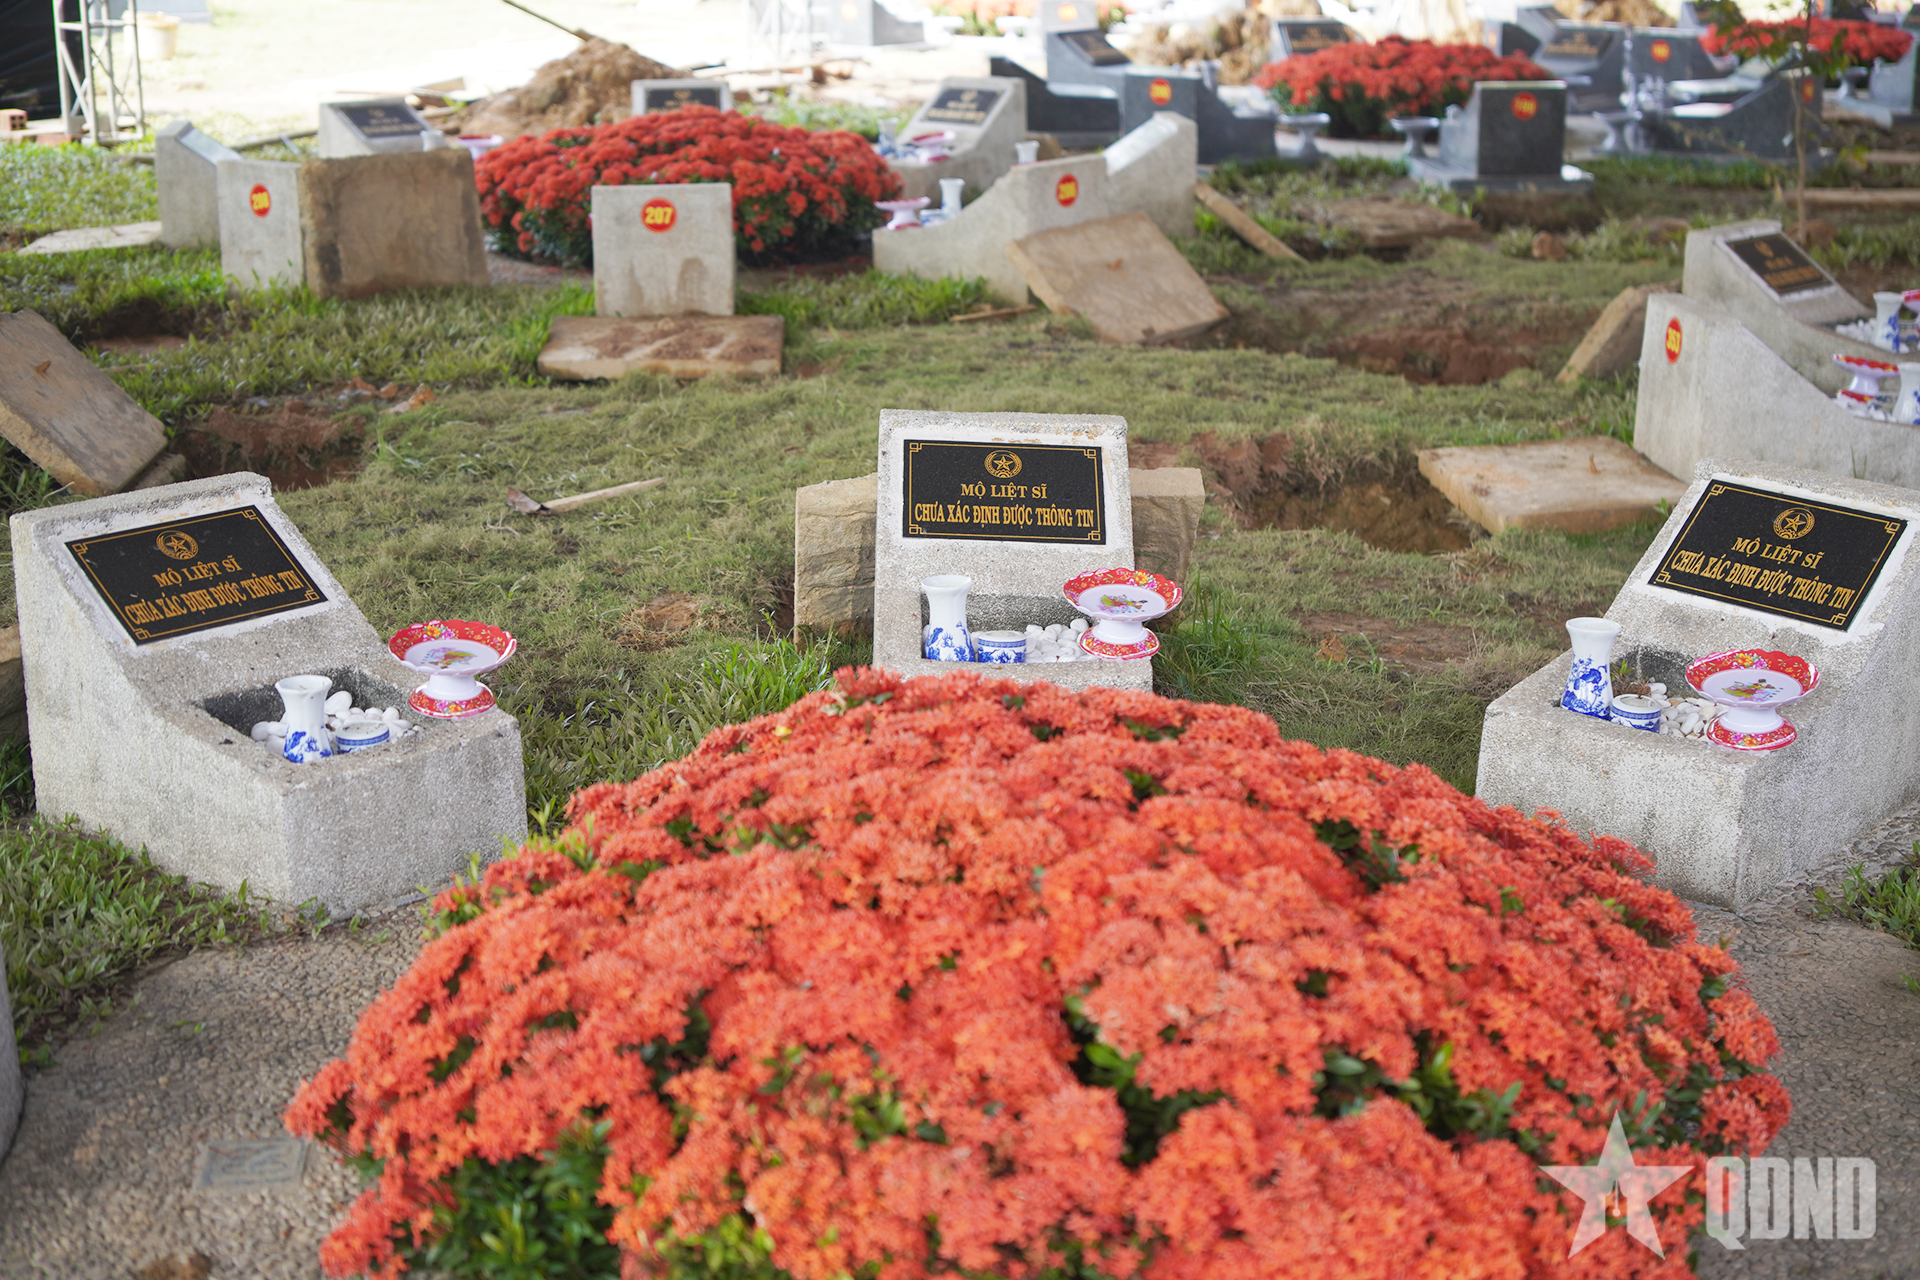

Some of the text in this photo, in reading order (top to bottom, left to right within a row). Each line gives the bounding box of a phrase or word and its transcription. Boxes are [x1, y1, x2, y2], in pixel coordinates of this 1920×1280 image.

[645, 206, 672, 224] 207
[1667, 326, 1680, 354] 353
[961, 481, 1048, 501] MỘ LIỆT SĨ
[914, 500, 1094, 530] CHƯA XÁC ĐỊNH ĐƯỢC THÔNG TIN
[1731, 537, 1826, 570] MỘ LIỆT SĨ
[152, 554, 243, 588] MỘ LIỆT SĨ
[1671, 550, 1856, 610] CHƯA XÁC ĐỊNH ĐƯỢC THÔNG TIN
[124, 569, 305, 625] CHƯA XÁC ĐỊNH ĐƯỢC THÔNG TIN
